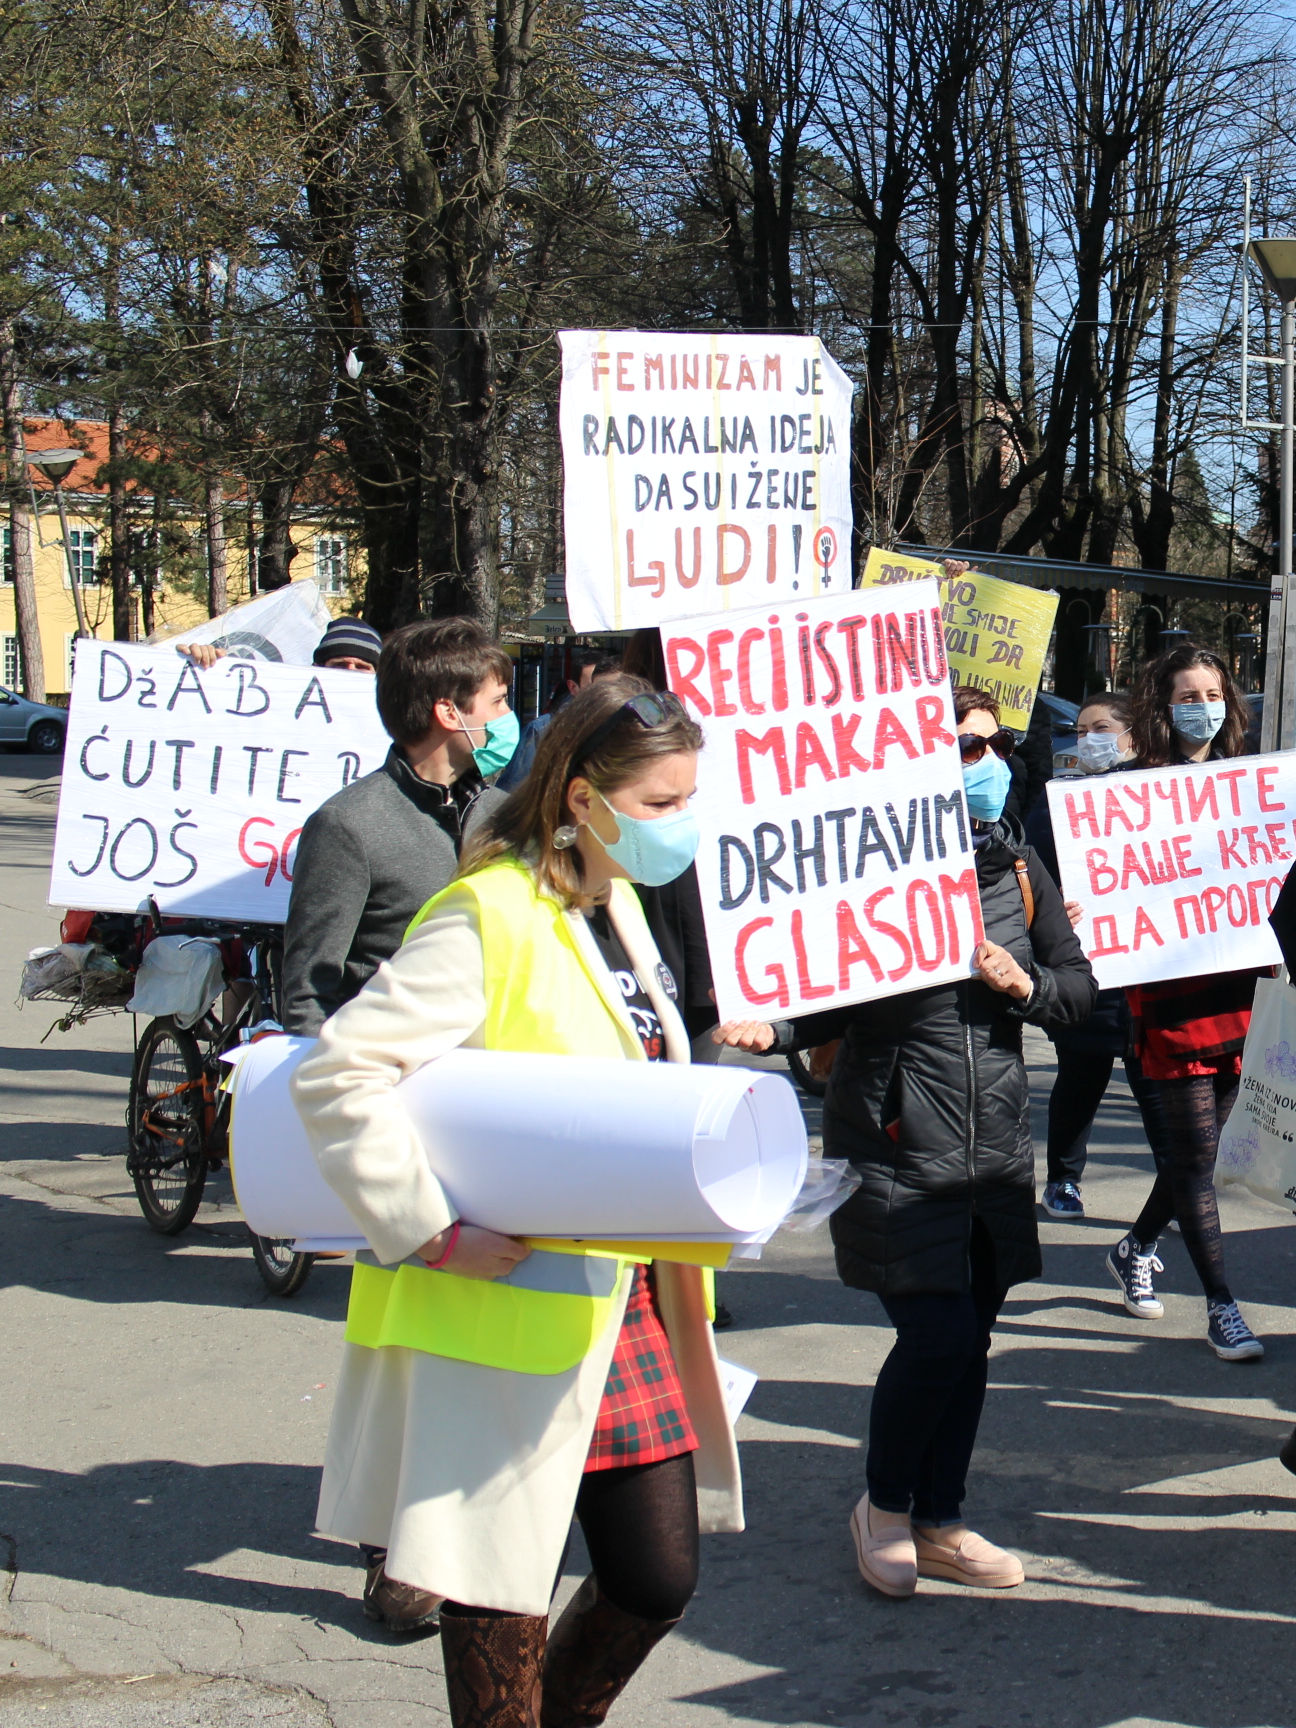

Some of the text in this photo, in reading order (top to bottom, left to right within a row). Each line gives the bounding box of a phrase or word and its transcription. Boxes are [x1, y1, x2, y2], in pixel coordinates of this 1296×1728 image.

[591, 352, 825, 395] FEMINIZAM JE
[582, 413, 837, 456] RADIKALNA IDEJA
[634, 473, 674, 512] DA
[746, 461, 818, 511] ŽENE
[962, 608, 1023, 639] SMIJE
[666, 606, 948, 718] RECI ISTINU
[79, 724, 309, 803] ĆUTITE
[734, 696, 957, 805] MAKAR
[1064, 766, 1286, 839] НАУЧИТЕ
[67, 808, 199, 888] JOŠ
[718, 789, 969, 911] DRHTAVIM
[1085, 834, 1203, 896] ВАШЕ
[734, 868, 985, 1008] GLASOM
[1088, 872, 1289, 961] ДА ПРОГО
[1245, 1102, 1261, 1117] SAMA
